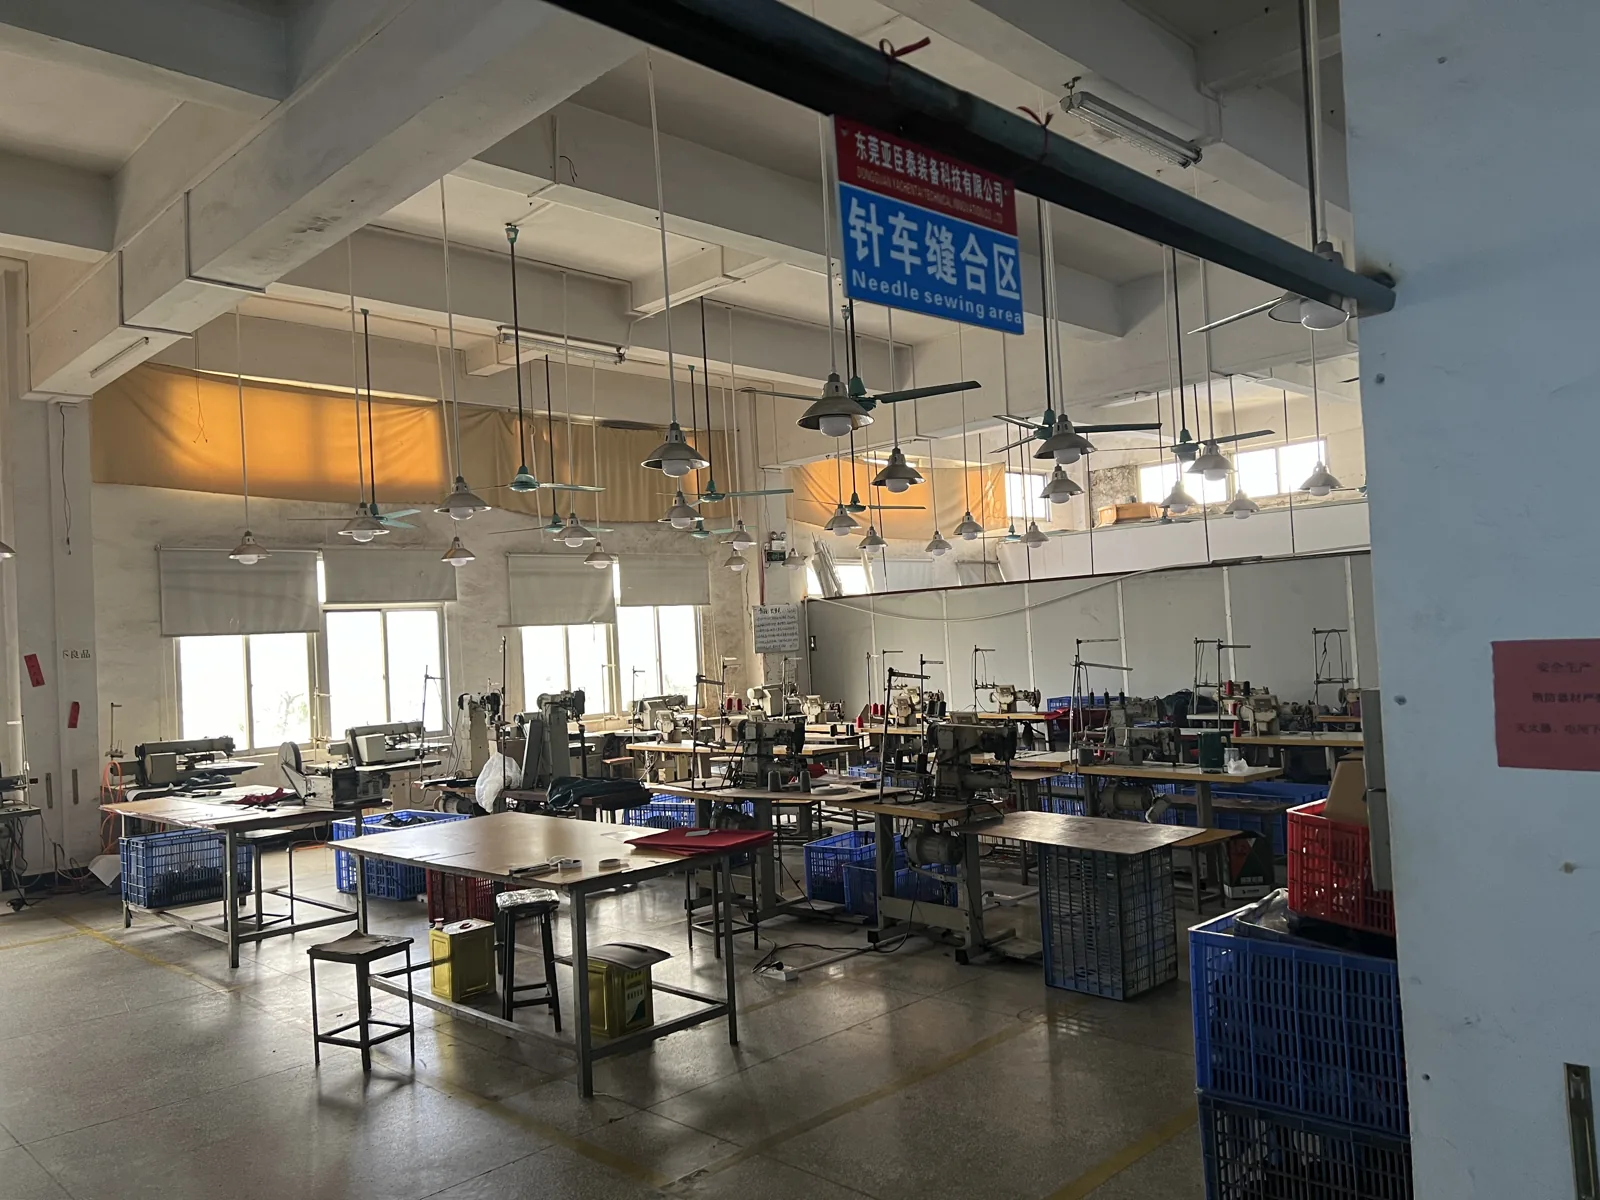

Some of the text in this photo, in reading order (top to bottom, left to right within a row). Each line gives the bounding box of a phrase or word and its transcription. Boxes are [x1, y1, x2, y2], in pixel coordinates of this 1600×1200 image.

[848, 196, 1020, 300] 针车缝合区
[852, 269, 1022, 325] Needle sewing area
